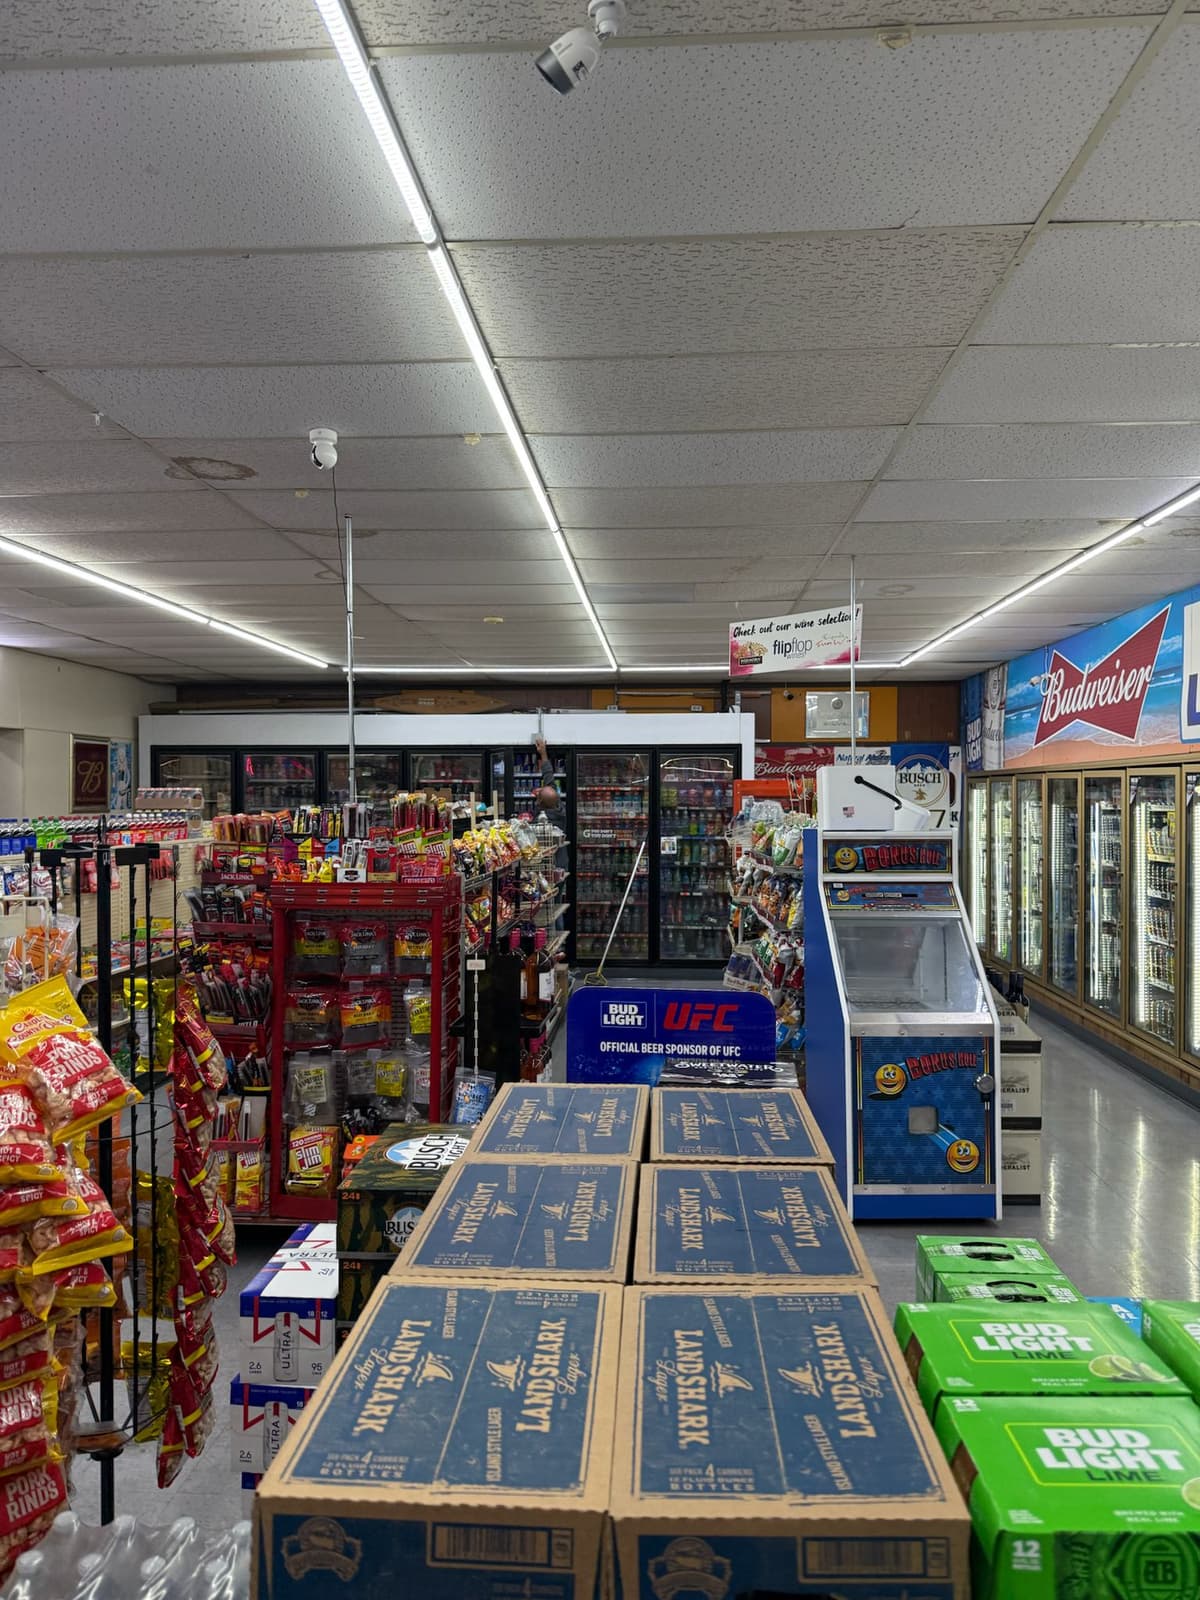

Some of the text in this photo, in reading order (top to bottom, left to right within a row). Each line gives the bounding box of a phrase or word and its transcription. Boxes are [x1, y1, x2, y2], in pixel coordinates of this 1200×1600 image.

[733, 625, 756, 638] Check
[760, 622, 773, 634] out
[776, 624, 791, 632] our
[795, 620, 814, 629] wine
[1040, 659, 1152, 723] Budweiser
[899, 773, 942, 784] BUSCH
[862, 845, 917, 871] BONUS
[221, 873, 236, 881] JACK
[602, 1014, 644, 1026] LIGHT
[609, 1003, 638, 1015] BUD
[663, 1002, 740, 1031] UFC
[600, 1041, 741, 1057] OFFICIAL BEER SPONSOR OF UFC
[55, 1050, 102, 1082] RINDS
[674, 1061, 784, 1073] SWEETWATER
[905, 1052, 955, 1080] BONUS
[506, 1098, 541, 1139] LANDSHARK
[593, 1097, 618, 1137] LANDSHARK
[680, 1102, 701, 1141] LANDSHARK
[761, 1102, 790, 1141] LANDSHARK
[291, 1140, 304, 1148] 120
[296, 1145, 321, 1159] slim
[405, 1133, 460, 1171] BUSCH
[445, 1140, 470, 1162] LIGHT
[301, 1152, 323, 1170] Jim
[20, 1191, 43, 1202] SPICY
[342, 1192, 355, 1200] 24
[445, 1197, 471, 1221] Lager
[453, 1182, 499, 1244] LANDSHARK
[564, 1180, 599, 1242] LANDSHARK
[591, 1199, 614, 1223] Lager
[659, 1202, 681, 1227] Lager
[678, 1187, 705, 1250] LANDSHARK
[781, 1186, 821, 1248] LANDSHARK
[811, 1204, 832, 1228] Lager
[384, 1220, 417, 1237] BUS
[343, 1262, 356, 1270] 24
[979, 1323, 1069, 1337] BUD
[282, 1331, 291, 1369] ULTRA
[972, 1336, 1094, 1352] LIGHT
[1011, 1351, 1077, 1360] LIME
[249, 1362, 262, 1370] 2.6
[312, 1363, 323, 1371] 95
[353, 1319, 433, 1434] LANDSHARK
[354, 1347, 390, 1391] Lager
[515, 1318, 567, 1433] LANDSHARK
[556, 1354, 588, 1395] Lager
[855, 1356, 886, 1399] Lager
[648, 1359, 678, 1402] Lager
[673, 1329, 711, 1449] LANDSHARK
[813, 1323, 877, 1439] LANDSHARK
[1042, 1428, 1151, 1448] BUD
[239, 1450, 252, 1459] 2.6
[361, 1450, 373, 1464] 4
[1035, 1447, 1184, 1470] LIGHT
[319, 1467, 403, 1478] BOTTLES
[705, 1463, 715, 1477] 4
[1084, 1470, 1165, 1482] LIME
[5, 1466, 53, 1501] PORK
[670, 1483, 755, 1491] BOTTLES
[5, 1479, 60, 1524] RINDS
[1012, 1540, 1040, 1557] 12
